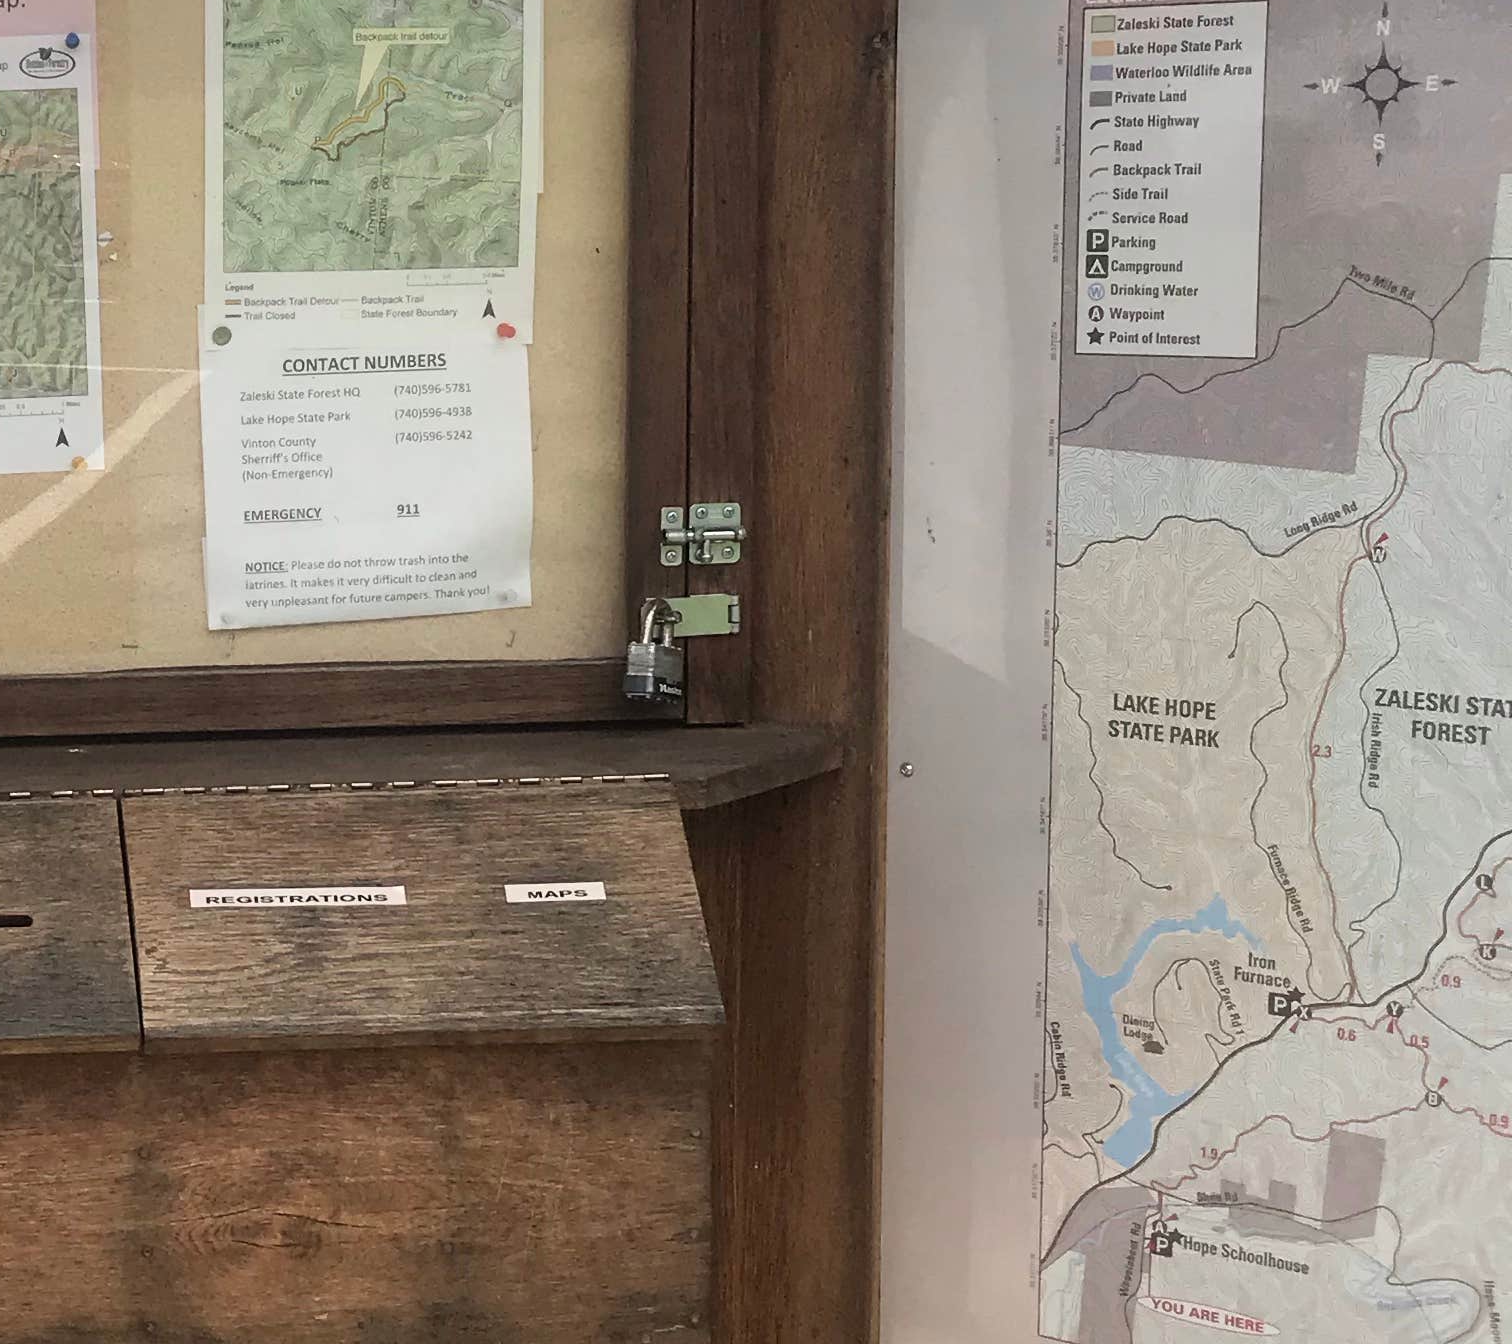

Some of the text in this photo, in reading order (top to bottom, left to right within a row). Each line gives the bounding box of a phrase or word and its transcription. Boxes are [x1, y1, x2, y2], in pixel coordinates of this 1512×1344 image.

[1117, 15, 1233, 31] Zaleski State Forest
[1117, 38, 1242, 56] Lake Hope State Park
[1116, 63, 1252, 80] Waterloo Wildlife Area
[1115, 89, 1186, 104] Private Land
[1114, 114, 1199, 130] State Highway
[1114, 139, 1142, 152] Road
[1113, 162, 1201, 179] Backpack Trail
[1113, 187, 1168, 200] Side Trail
[1112, 211, 1188, 224] Service Road
[1112, 235, 1155, 251] Parking
[1111, 259, 1183, 275] Campground
[1111, 283, 1198, 299] Drinking Water
[1110, 307, 1164, 323] Waypoint
[1109, 330, 1200, 345] Point of Interest
[283, 353, 447, 373] CONTACT NUMBERS
[240, 387, 360, 402] Zaleski State Forest HQ
[394, 382, 471, 398] (740)596-5781
[241, 410, 351, 426] Lake Hope State Park
[241, 437, 317, 451] Vinton County
[396, 429, 472, 445] (740)596-5242
[291, 451, 322, 463] Office
[242, 466, 334, 484] (Non-Emergency)
[244, 508, 322, 522] EMERGENCY
[397, 503, 420, 517] 911
[1112, 691, 1218, 721] LAKE HOPE
[1375, 687, 1459, 716] ZALESKI
[1108, 719, 1220, 749] STATE PARK
[1411, 719, 1492, 746] FOREST
[205, 894, 388, 905] REGISTRATIONS
[527, 889, 588, 900] MAPS
[1248, 952, 1276, 971] Iron
[1234, 966, 1291, 989] Furnace
[1183, 1234, 1309, 1275] Hope Schoolhouse
[1151, 1299, 1265, 1334] YOU ARE HERE
